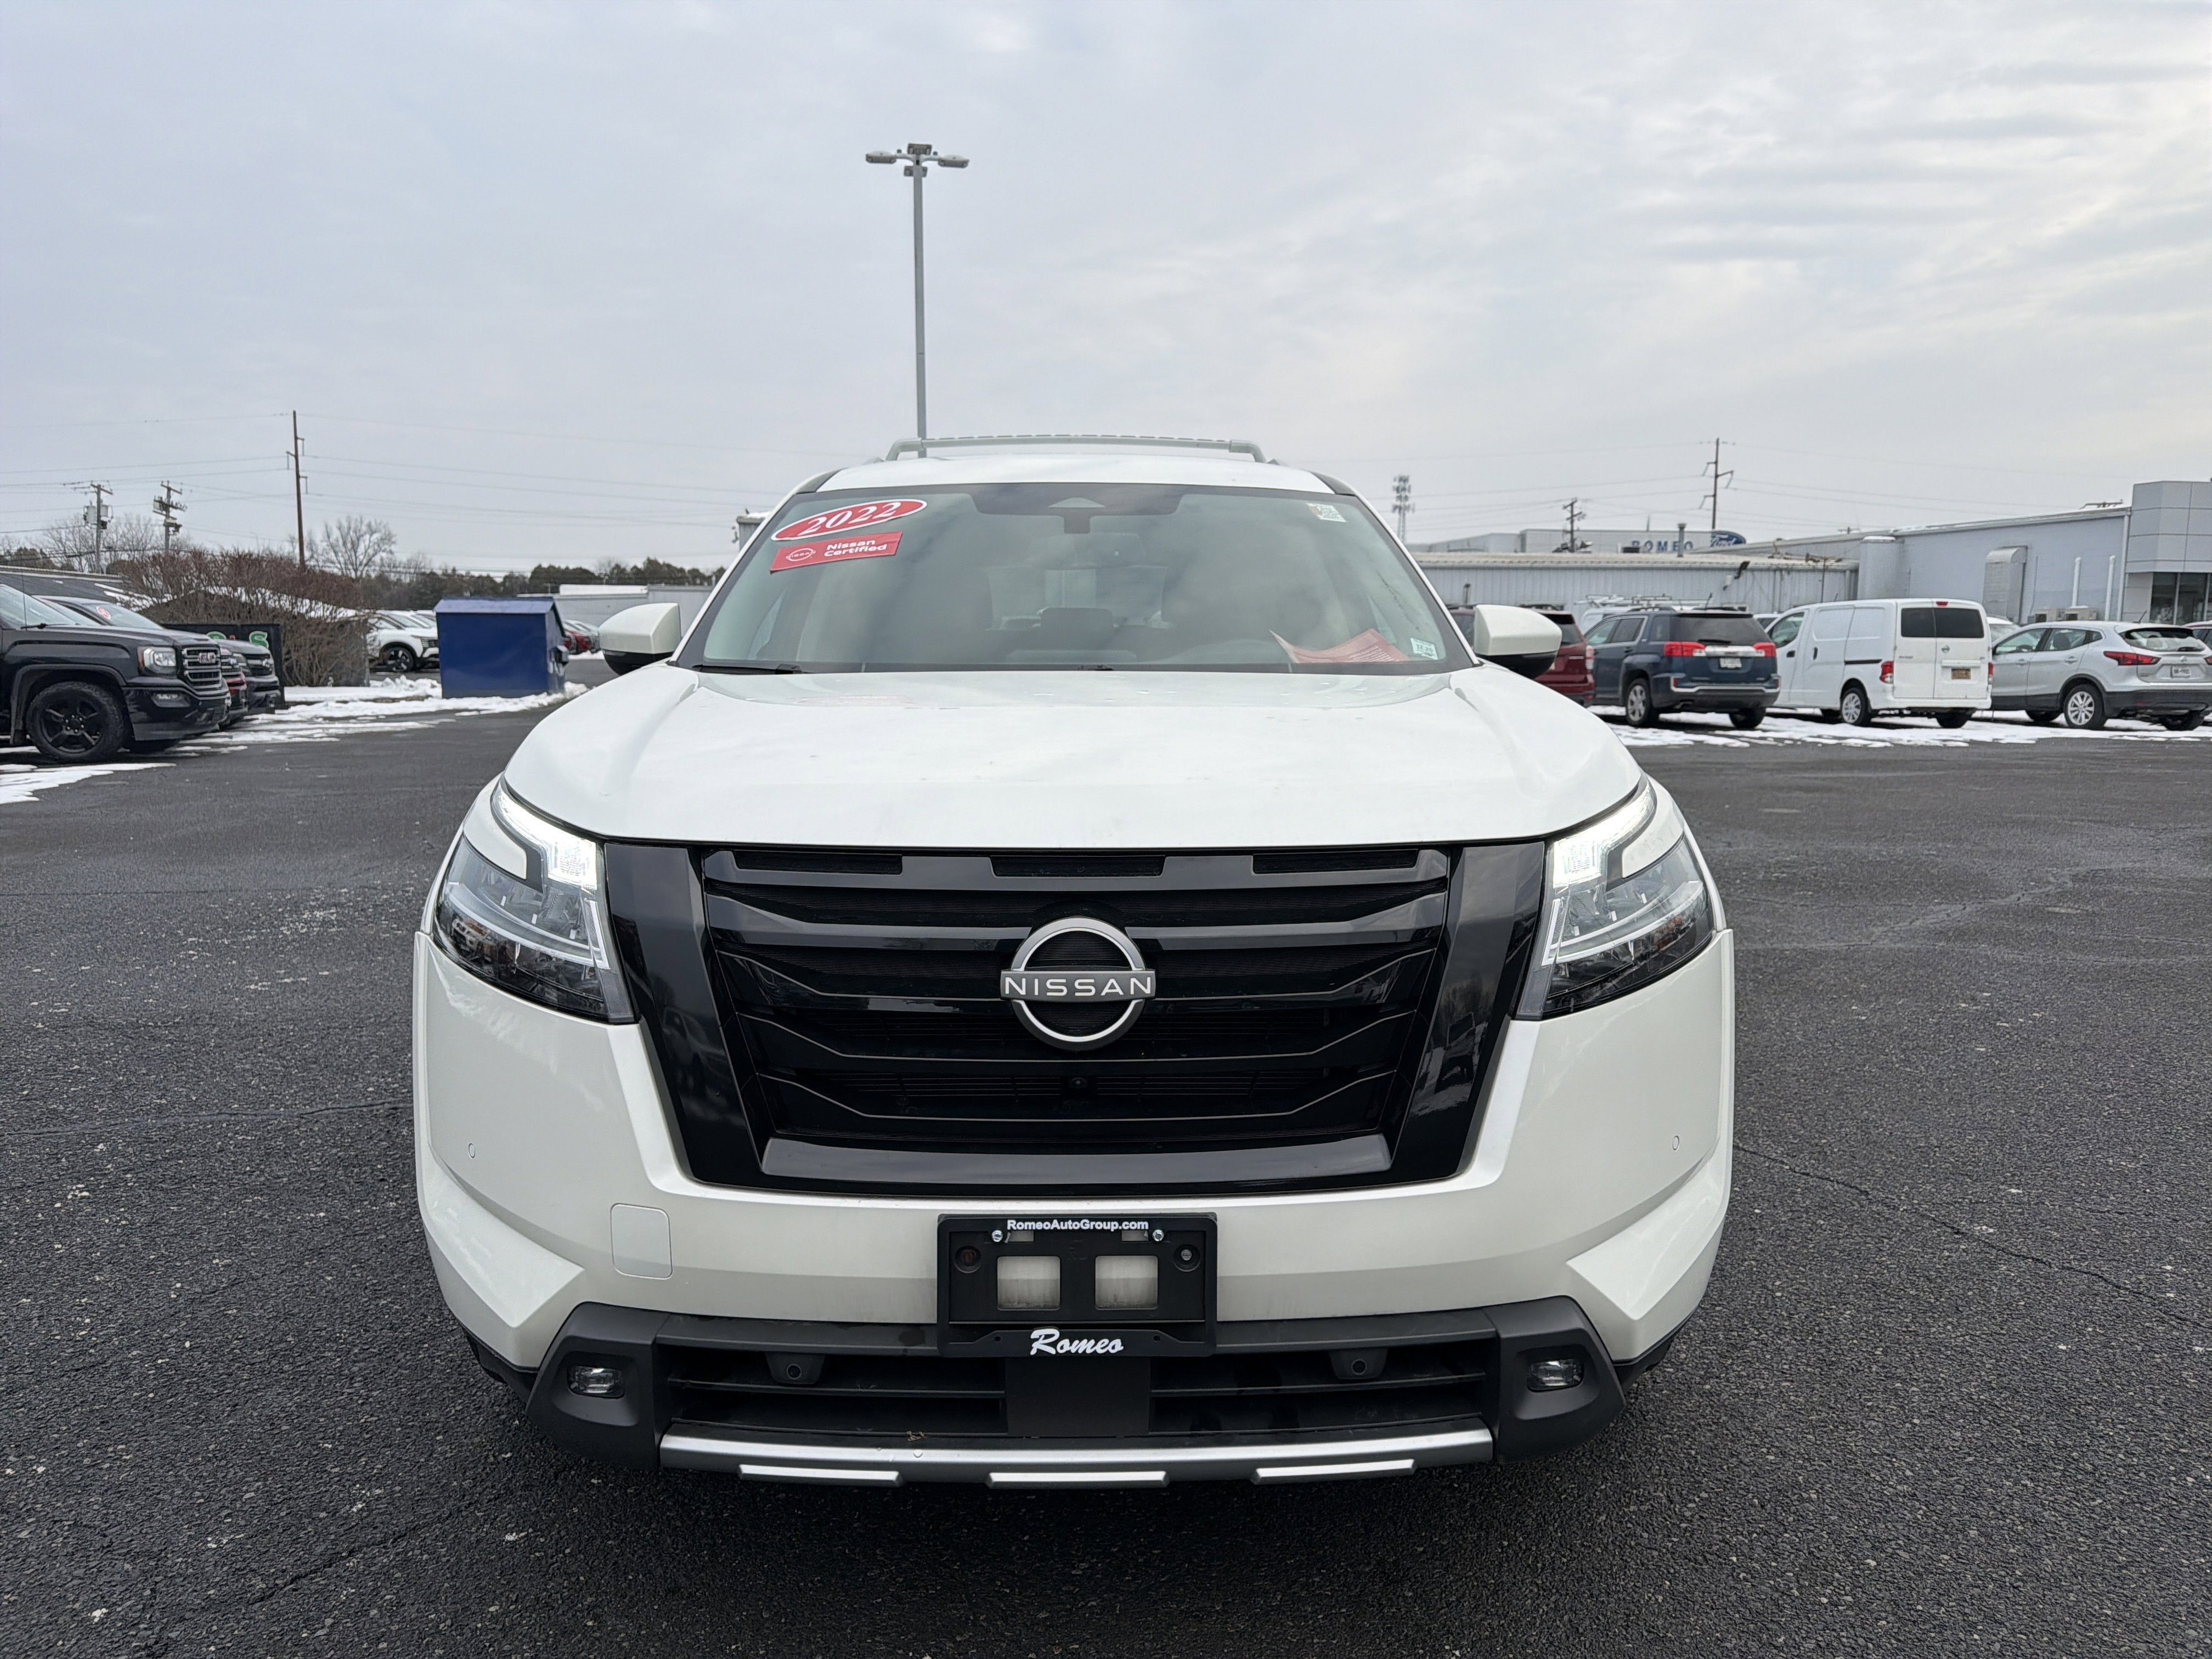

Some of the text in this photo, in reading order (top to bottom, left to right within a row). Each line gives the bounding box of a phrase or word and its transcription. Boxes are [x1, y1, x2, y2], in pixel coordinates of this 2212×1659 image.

[797, 502, 901, 536] 2022
[824, 544, 888, 557] Certified
[827, 540, 876, 550] Nissan
[1005, 977, 1151, 996] NISSAN
[1007, 1219, 1149, 1232] RomeoAutoGroup.com
[1030, 1328, 1124, 1356] Romeo
